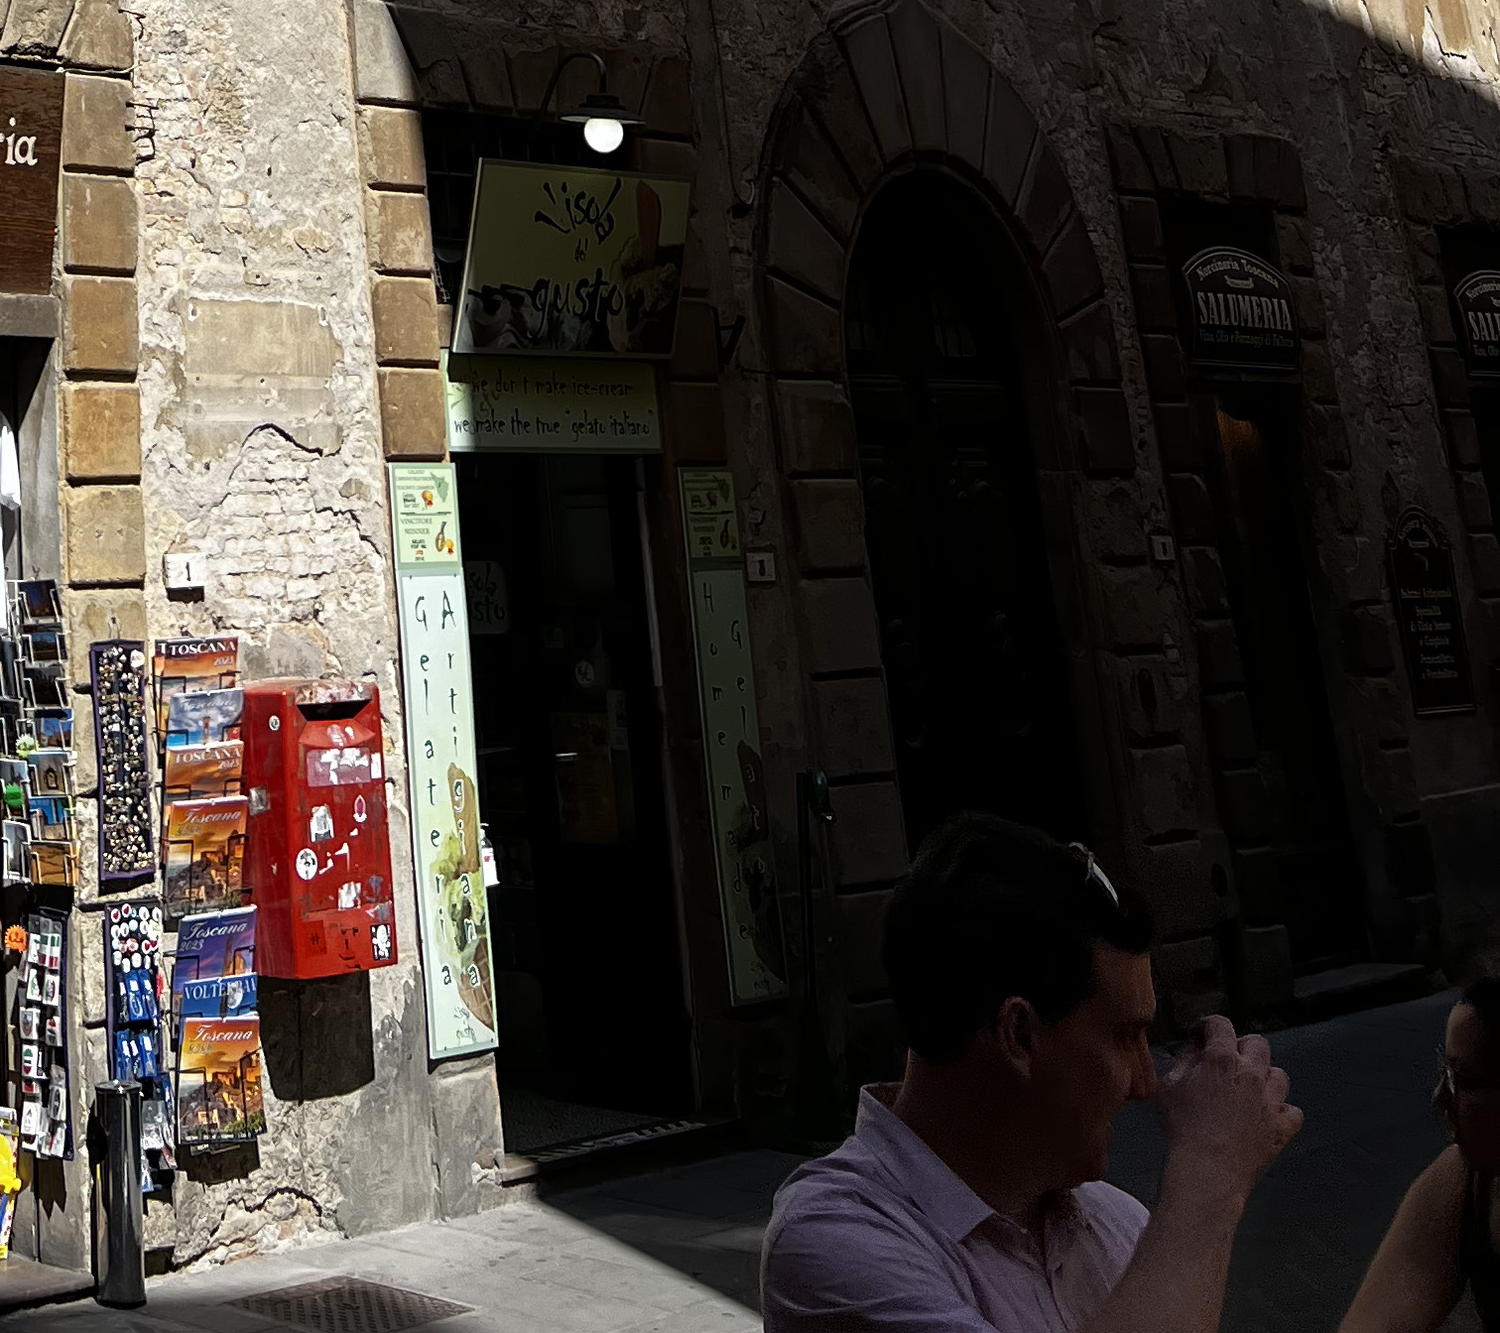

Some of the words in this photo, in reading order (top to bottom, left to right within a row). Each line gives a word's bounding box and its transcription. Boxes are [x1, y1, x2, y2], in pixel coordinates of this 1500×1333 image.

[533, 268, 625, 343] gusto
[1197, 291, 1293, 331] SALUMERIA
[536, 370, 566, 396] make
[572, 375, 633, 397] ice-cream
[454, 417, 470, 432] we
[475, 408, 505, 434] make
[511, 408, 530, 435] the
[536, 416, 561, 435] true
[169, 641, 236, 655] TOSCANA
[213, 655, 235, 666] 2023
[174, 747, 241, 764] TOSCANA
[218, 759, 240, 770] 2023
[180, 805, 242, 824] Toscana
[183, 920, 248, 941] Toscana
[179, 938, 204, 952] 2023
[192, 1024, 253, 1042] Toscana
